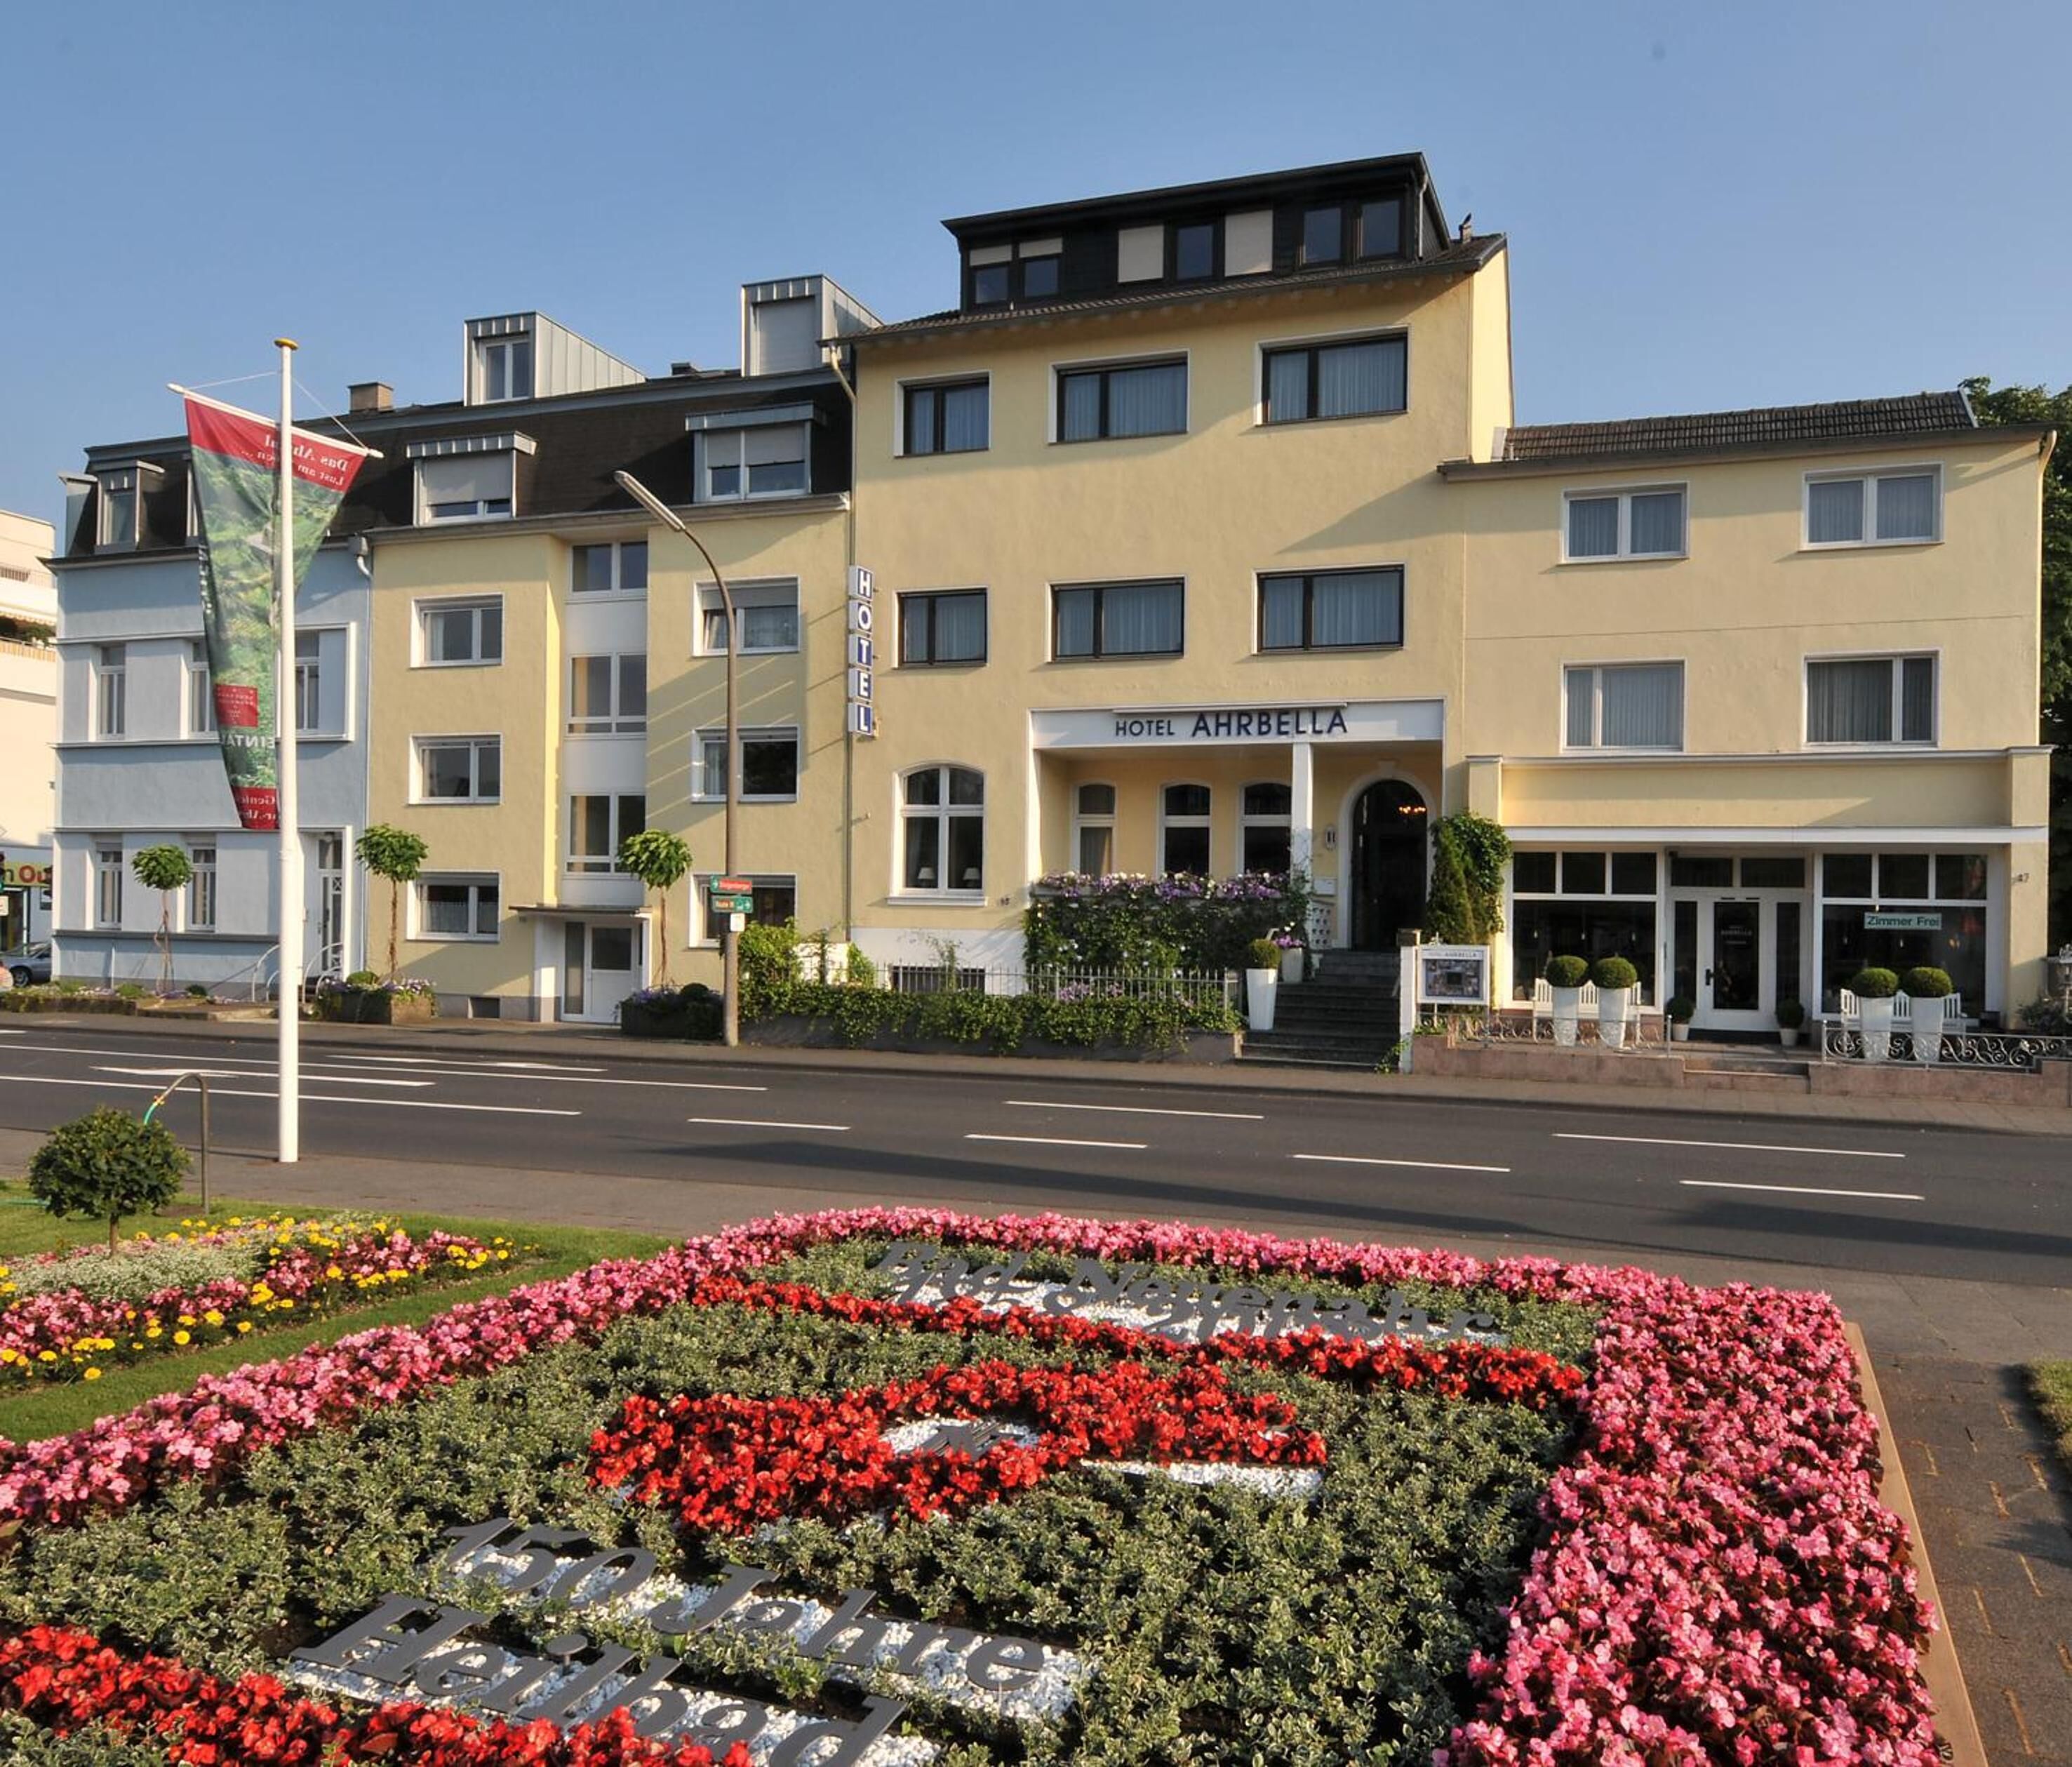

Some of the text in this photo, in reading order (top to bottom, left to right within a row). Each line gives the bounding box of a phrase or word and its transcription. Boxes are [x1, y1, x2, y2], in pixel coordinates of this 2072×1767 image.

[858, 569, 872, 732] HOTEL
[1115, 707, 1348, 737] HOTEL AHRBELLA
[1867, 916, 1939, 926] Zimmer Frei
[289, 1592, 909, 1767] Heilbad
[649, 1563, 1045, 1692] Jahre
